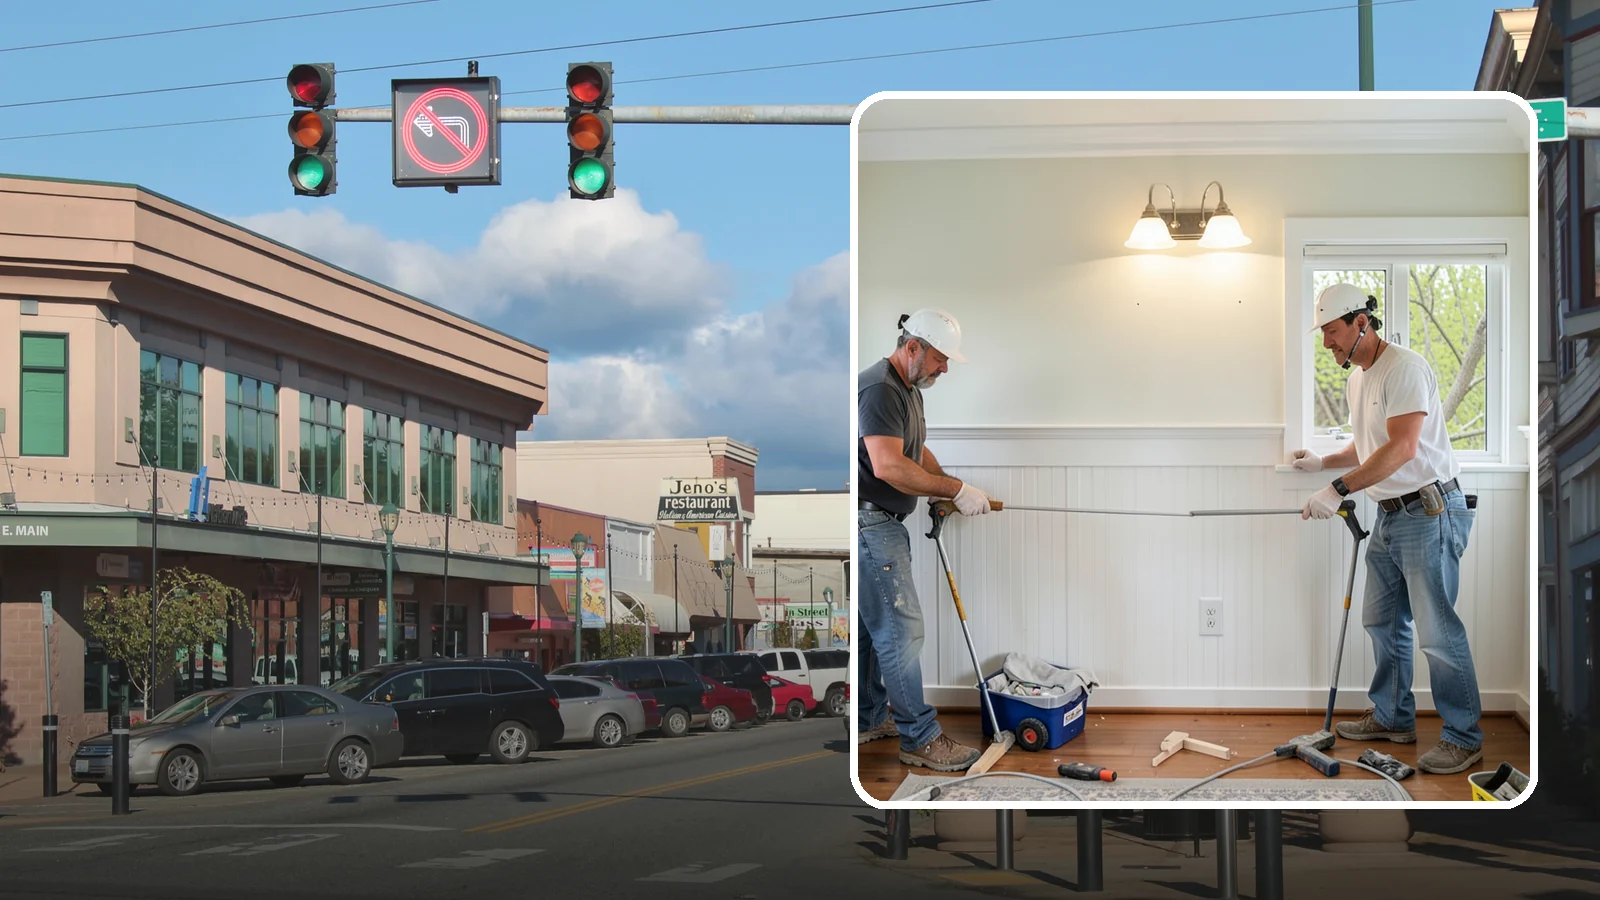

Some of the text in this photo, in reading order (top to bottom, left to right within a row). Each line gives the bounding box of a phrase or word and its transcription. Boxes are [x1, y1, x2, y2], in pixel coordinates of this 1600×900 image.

[670, 480, 727, 494] Jeno's
[665, 497, 731, 509] restaurant
[658, 510, 681, 520] Italian
[686, 510, 714, 519] American
[715, 510, 737, 520] Cuisine
[2, 525, 49, 536] E. MAIN
[797, 607, 828, 617] Street
